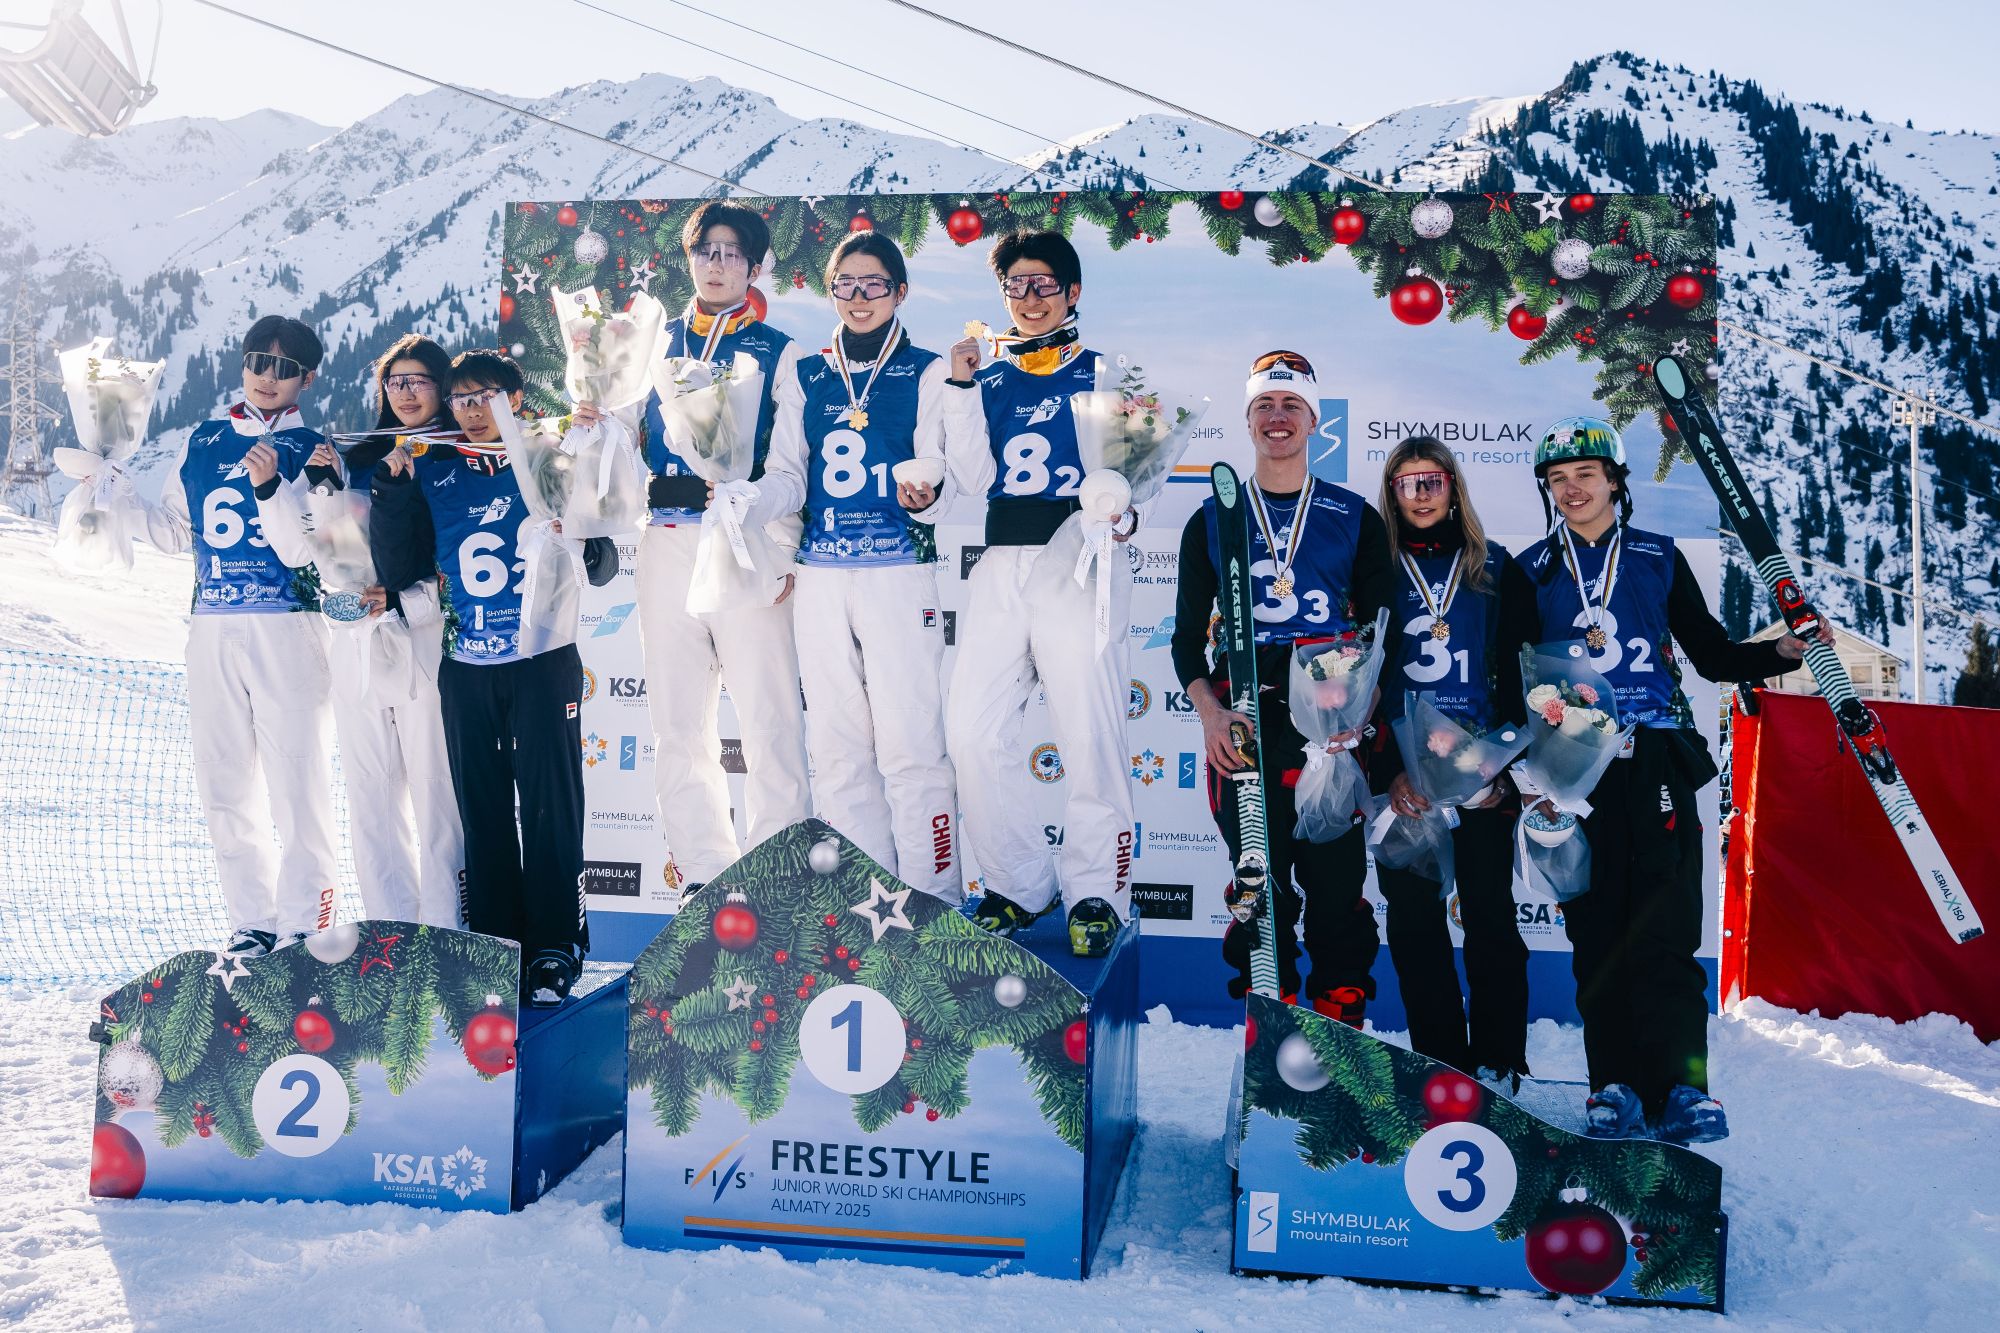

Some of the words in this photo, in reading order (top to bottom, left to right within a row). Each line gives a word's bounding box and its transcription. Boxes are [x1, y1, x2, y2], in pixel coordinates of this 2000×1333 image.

[1015, 405, 1036, 414] Sport
[1367, 421, 1533, 442] SHYMBULAK
[1472, 450, 1532, 464] resort
[468, 504, 488, 514] Sport
[812, 540, 835, 553] KSA
[1156, 577, 1178, 585] PART
[580, 615, 602, 624] Sport
[1130, 625, 1155, 636] Sport
[464, 637, 488, 651] KSA
[1164, 691, 1198, 713] KS
[1660, 784, 1674, 813] ANTA
[591, 811, 655, 822] SHYMBULAK
[590, 822, 629, 831] mountain
[630, 823, 654, 831] resort
[931, 813, 952, 874] CHINA
[1148, 831, 1218, 843] SHYMBULAK
[1148, 843, 1190, 851] mountain
[1192, 844, 1217, 852] resort
[1114, 830, 1132, 895] CHINA
[317, 888, 334, 932] CHIN
[830, 1000, 863, 1073] 1
[276, 1069, 321, 1139] 2
[372, 1152, 437, 1185] KSA
[771, 1139, 990, 1184] FREESTYLE
[1437, 1140, 1486, 1213] 3
[383, 1185, 425, 1193] KAZAKHSTAN
[394, 1192, 437, 1200] ASSOCIATION
[771, 1178, 821, 1194] JUNIOR
[825, 1182, 878, 1198] WORLD
[882, 1185, 903, 1200] SKI
[907, 1187, 1026, 1207] CHAMPIONSHIPS
[771, 1198, 831, 1215] ALMATY
[834, 1202, 871, 1217] 2025
[1291, 1210, 1411, 1232] SHYMBULAK
[1290, 1229, 1362, 1244] mountain
[1366, 1235, 1409, 1248] resort
